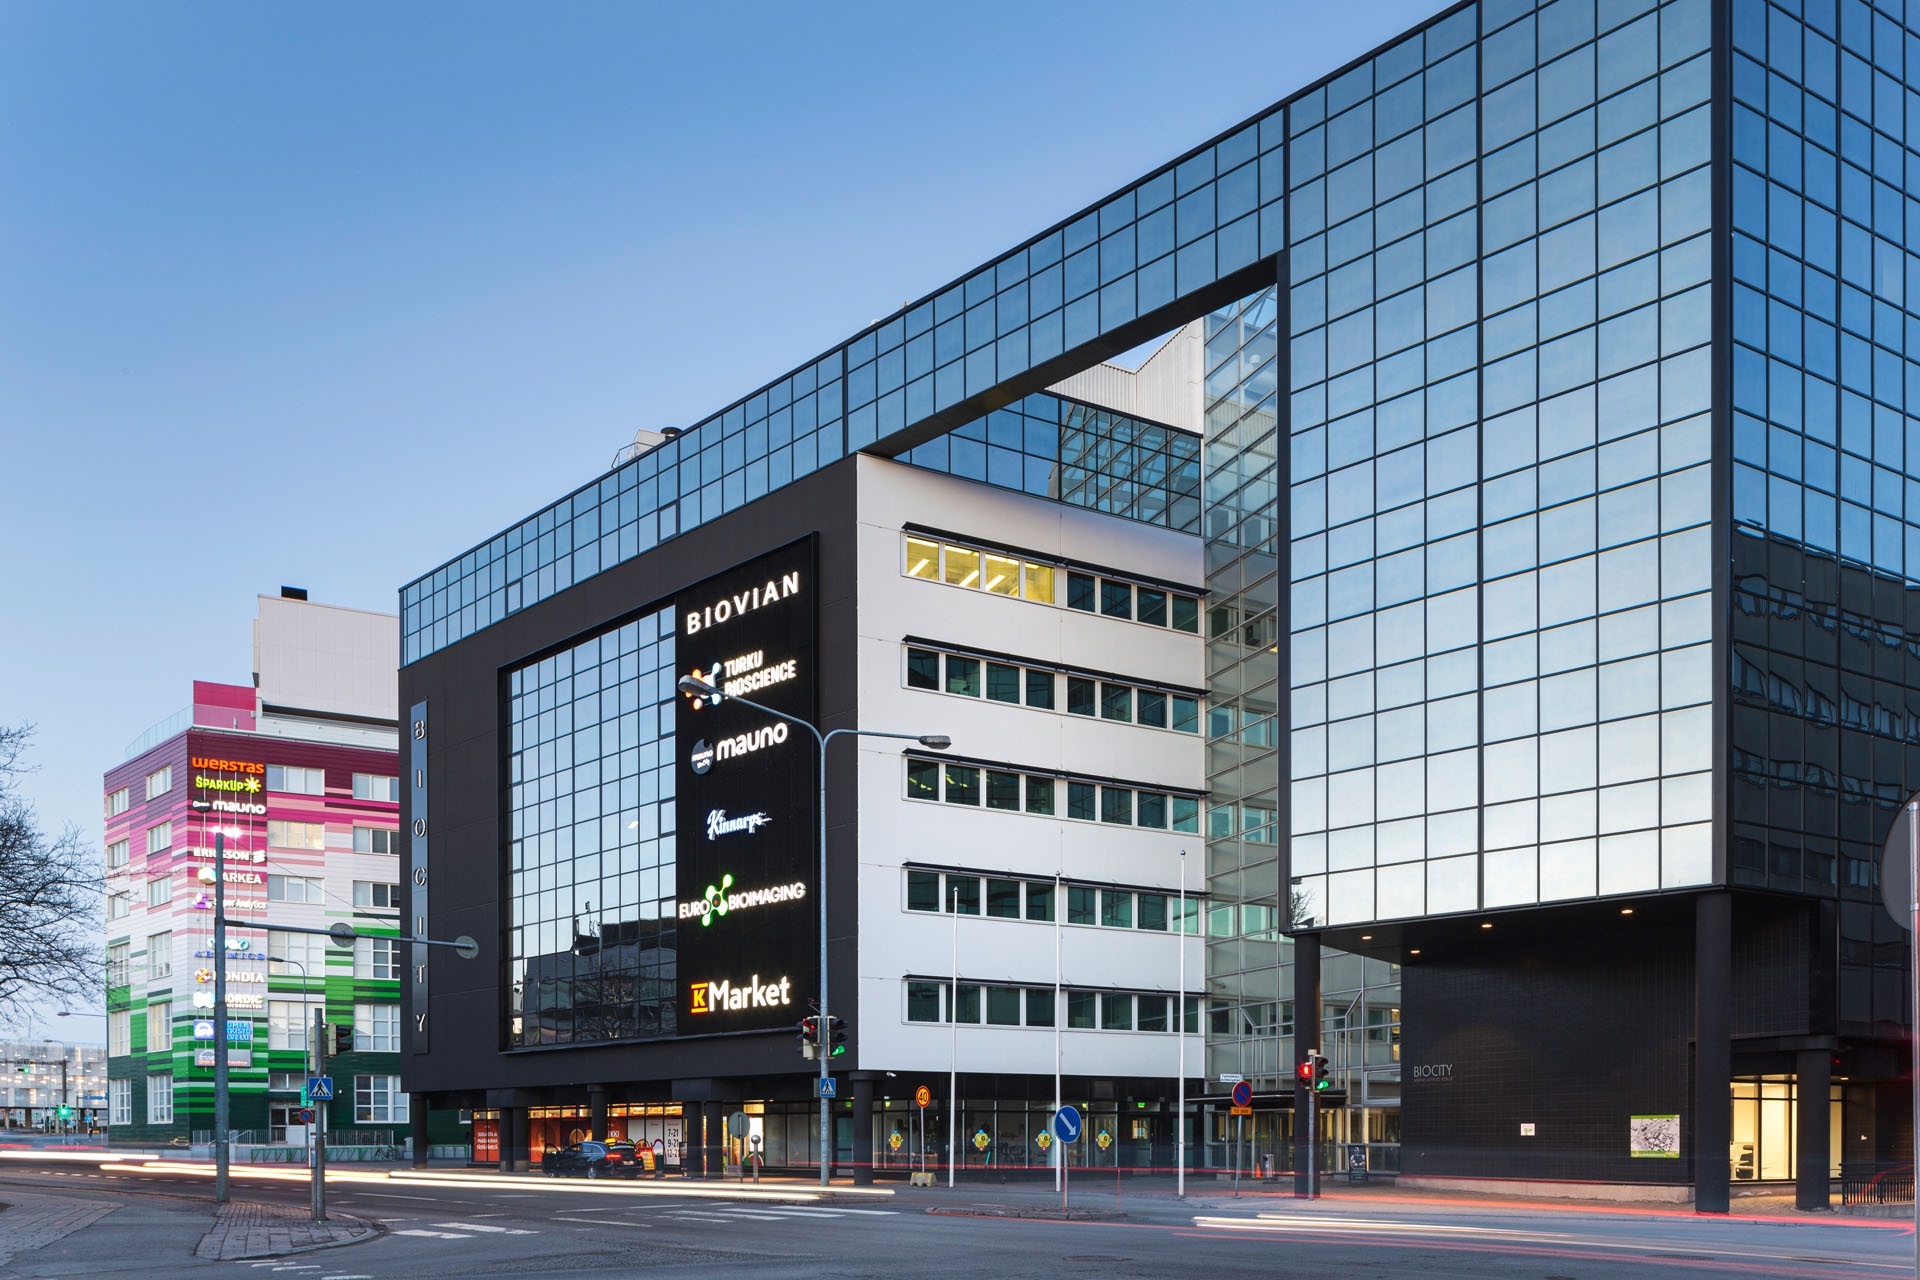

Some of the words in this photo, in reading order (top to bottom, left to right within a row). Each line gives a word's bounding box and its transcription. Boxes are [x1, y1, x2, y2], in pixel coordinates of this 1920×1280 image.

[687, 571, 799, 635] BIOVIAN
[724, 650, 764, 678] TURKU
[724, 659, 797, 699] BIOSCIENCE
[716, 722, 788, 761] mauno
[212, 800, 266, 815] mauno
[707, 808, 768, 841] Kinnarps
[413, 719, 427, 1033] BIOCITY
[679, 899, 710, 919] EURO
[728, 881, 807, 911] BIOIMAGING
[193, 950, 265, 960] ABMICS
[708, 974, 791, 1012] Market
[1413, 1063, 1453, 1078] BIOCITY
[919, 1091, 928, 1102] 40
